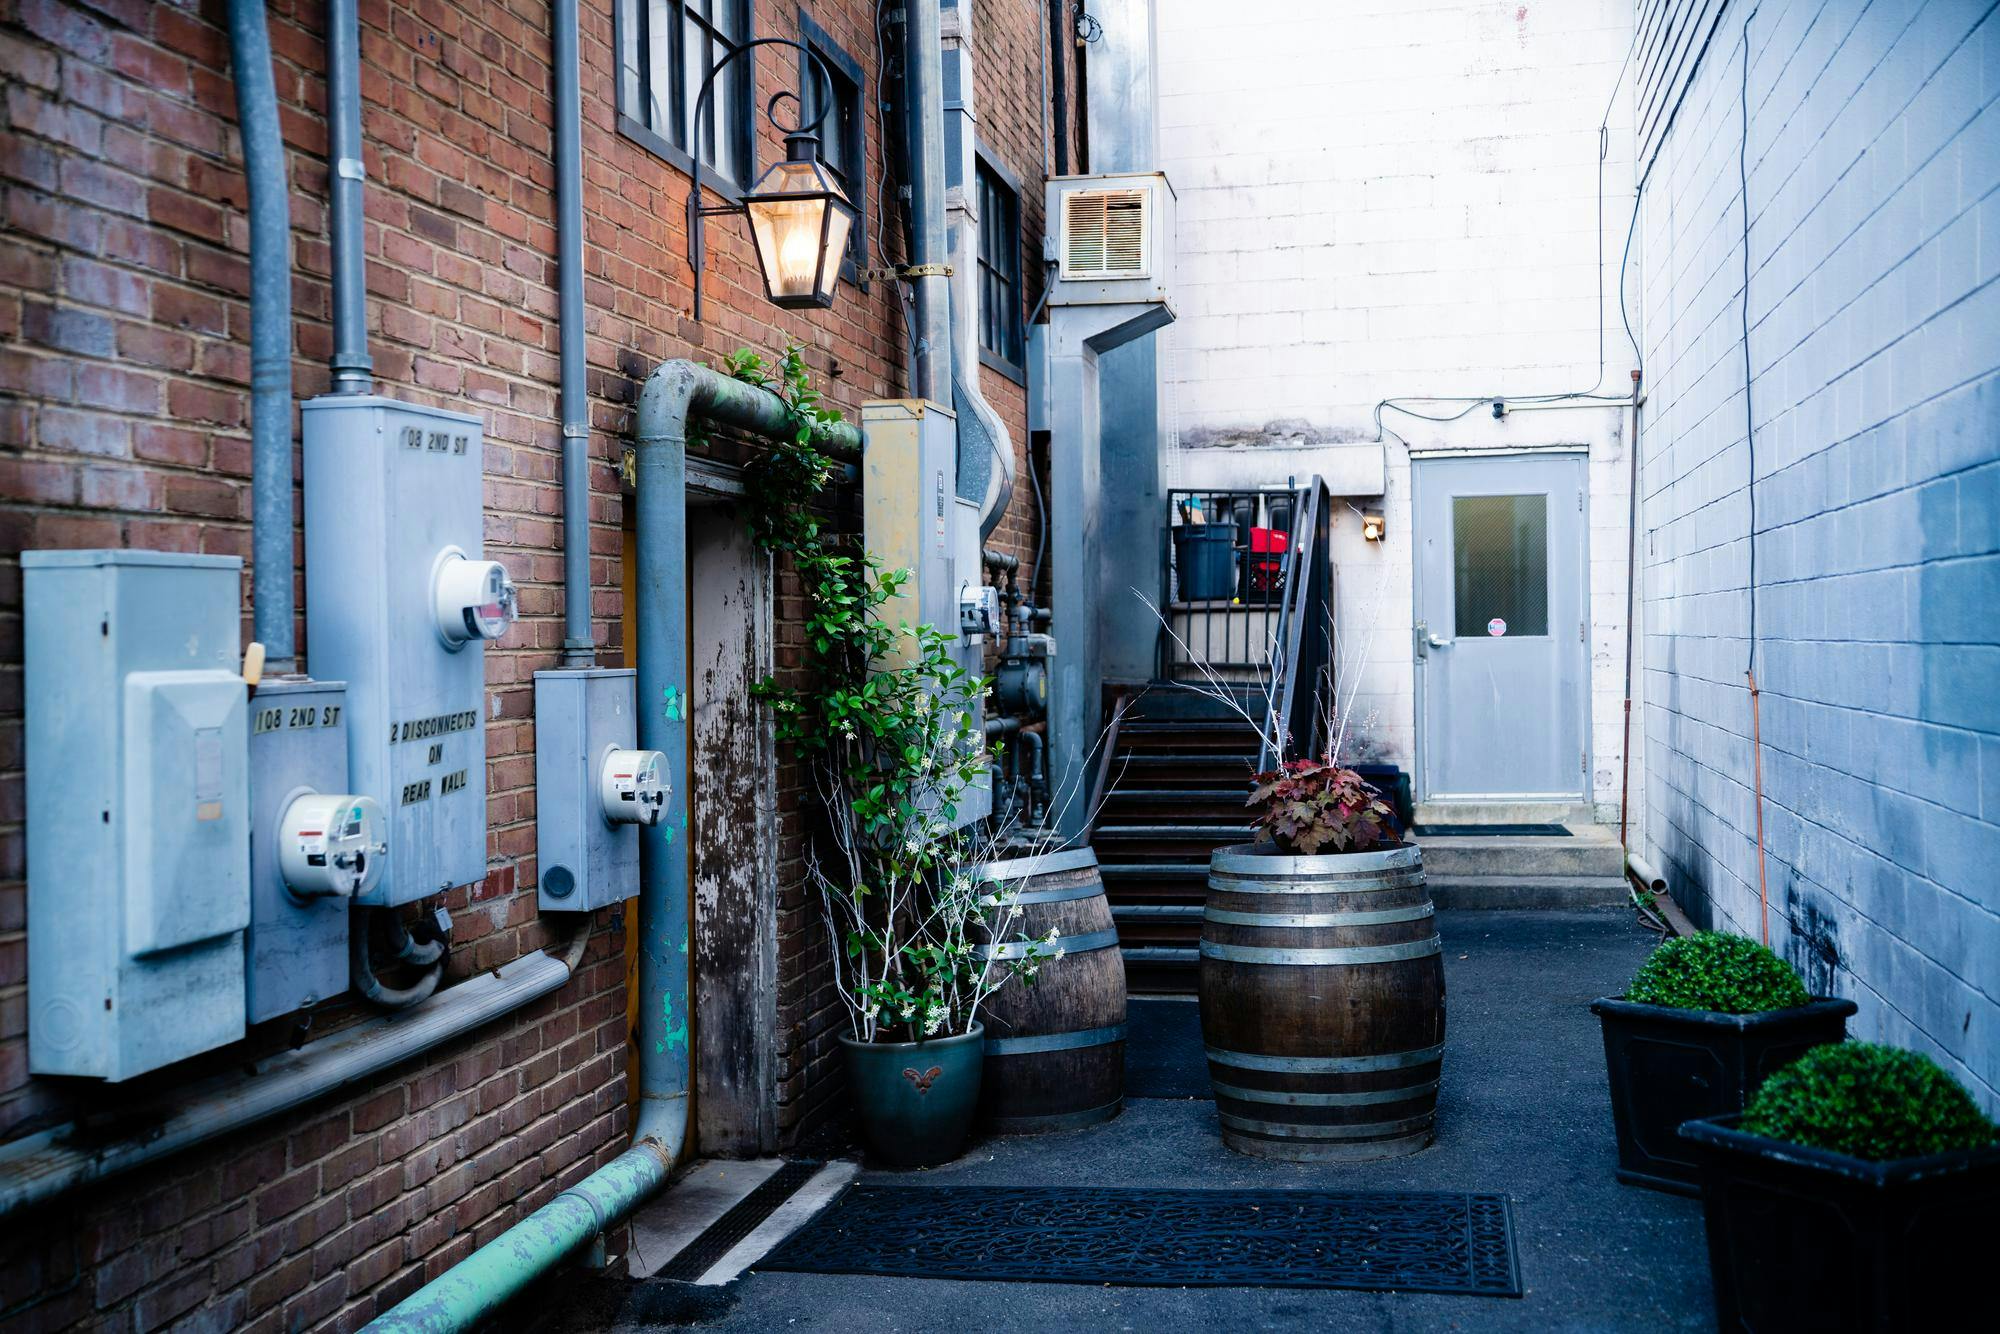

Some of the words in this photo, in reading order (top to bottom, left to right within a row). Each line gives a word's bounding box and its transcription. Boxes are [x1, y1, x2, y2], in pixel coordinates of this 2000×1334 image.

[428, 433, 449, 450] 2ND
[454, 436, 468, 453] ST
[256, 708, 282, 731] 108
[290, 706, 316, 727] 2ND
[323, 706, 340, 726] ST
[391, 723, 398, 742] 2
[402, 711, 477, 741] DISCONNECTS
[429, 743, 443, 764] ON
[402, 781, 430, 805] REAR
[441, 770, 467, 795] WALL
